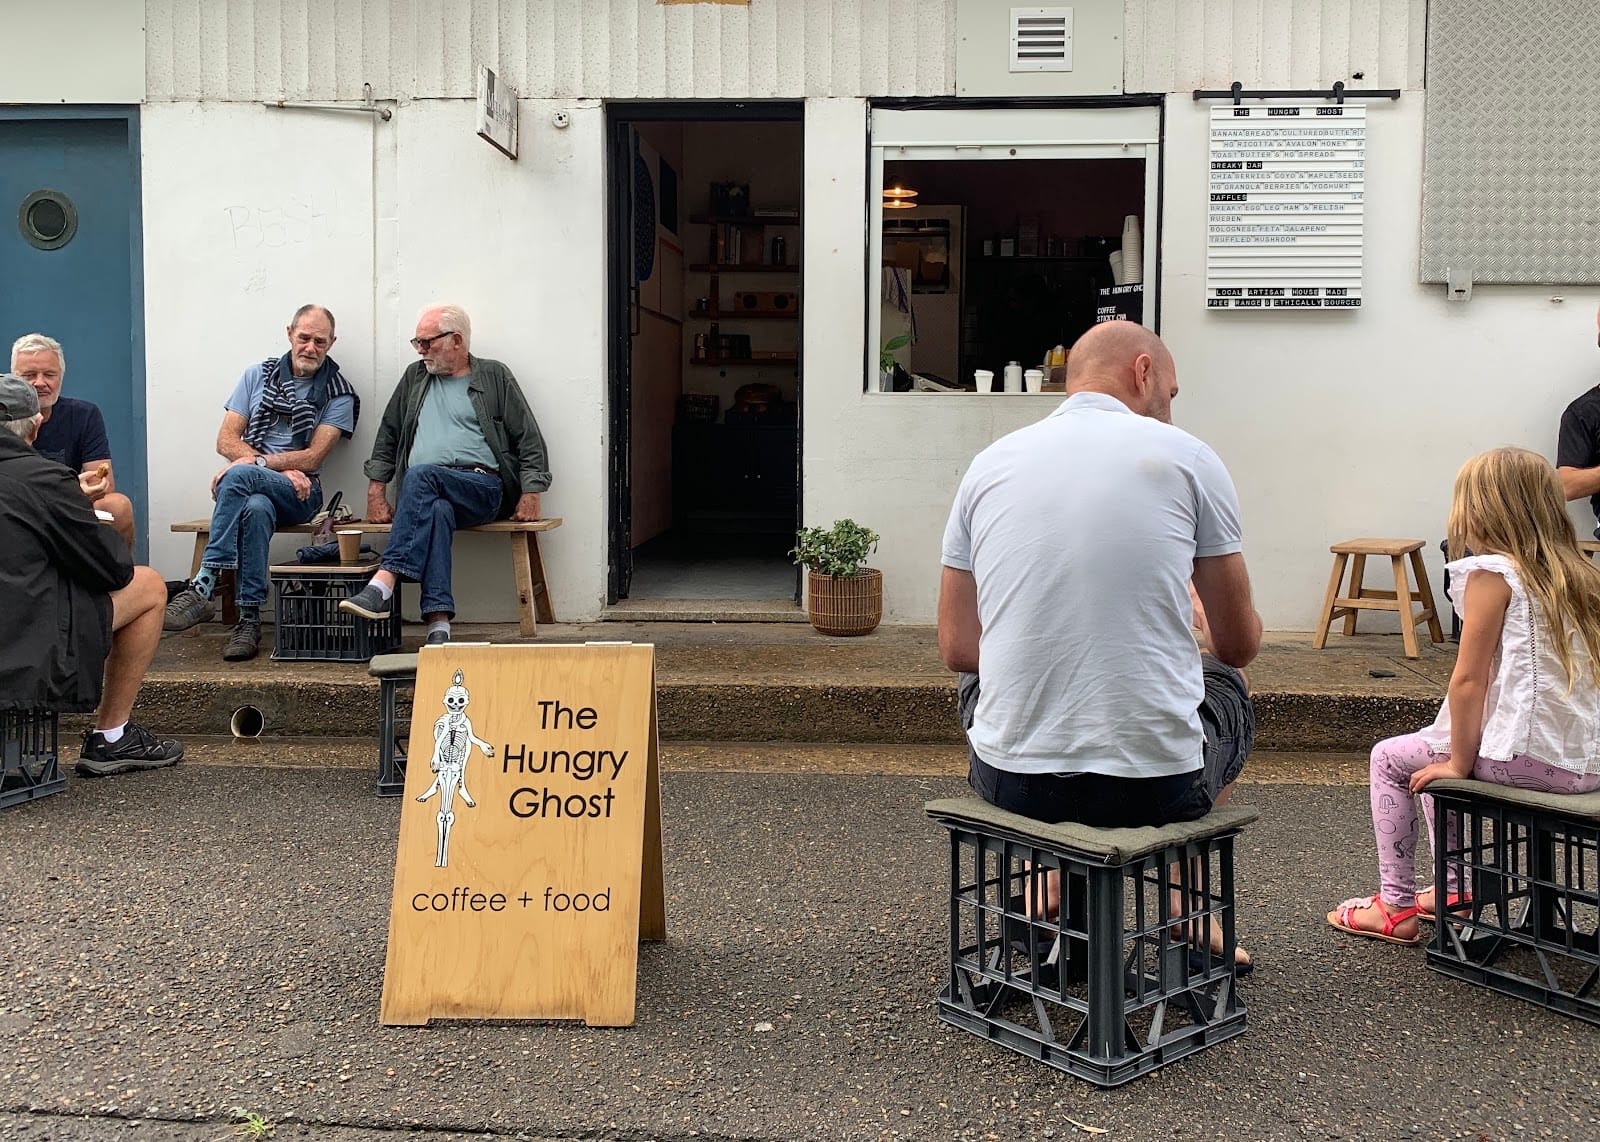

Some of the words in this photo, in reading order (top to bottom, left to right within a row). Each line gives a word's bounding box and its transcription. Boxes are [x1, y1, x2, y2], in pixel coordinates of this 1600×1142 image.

[1234, 108, 1249, 116] THE
[1316, 107, 1343, 115] GHOST
[1247, 161, 1262, 169] JAR
[1211, 193, 1247, 201] JAFFLES
[1216, 288, 1242, 296] LOCAL
[1248, 288, 1284, 296] ARTISAN
[1208, 299, 1229, 307] FREE
[1274, 298, 1321, 306] ETHICALLY
[1324, 298, 1361, 306] SOURCED
[1097, 306, 1116, 314] COFFEE
[1096, 314, 1115, 322] STICKY
[537, 700, 598, 730] The
[503, 744, 629, 781] Hungry
[509, 787, 616, 818] Ghost
[411, 886, 507, 912] coffee
[517, 891, 533, 908] +
[543, 886, 611, 912] food
